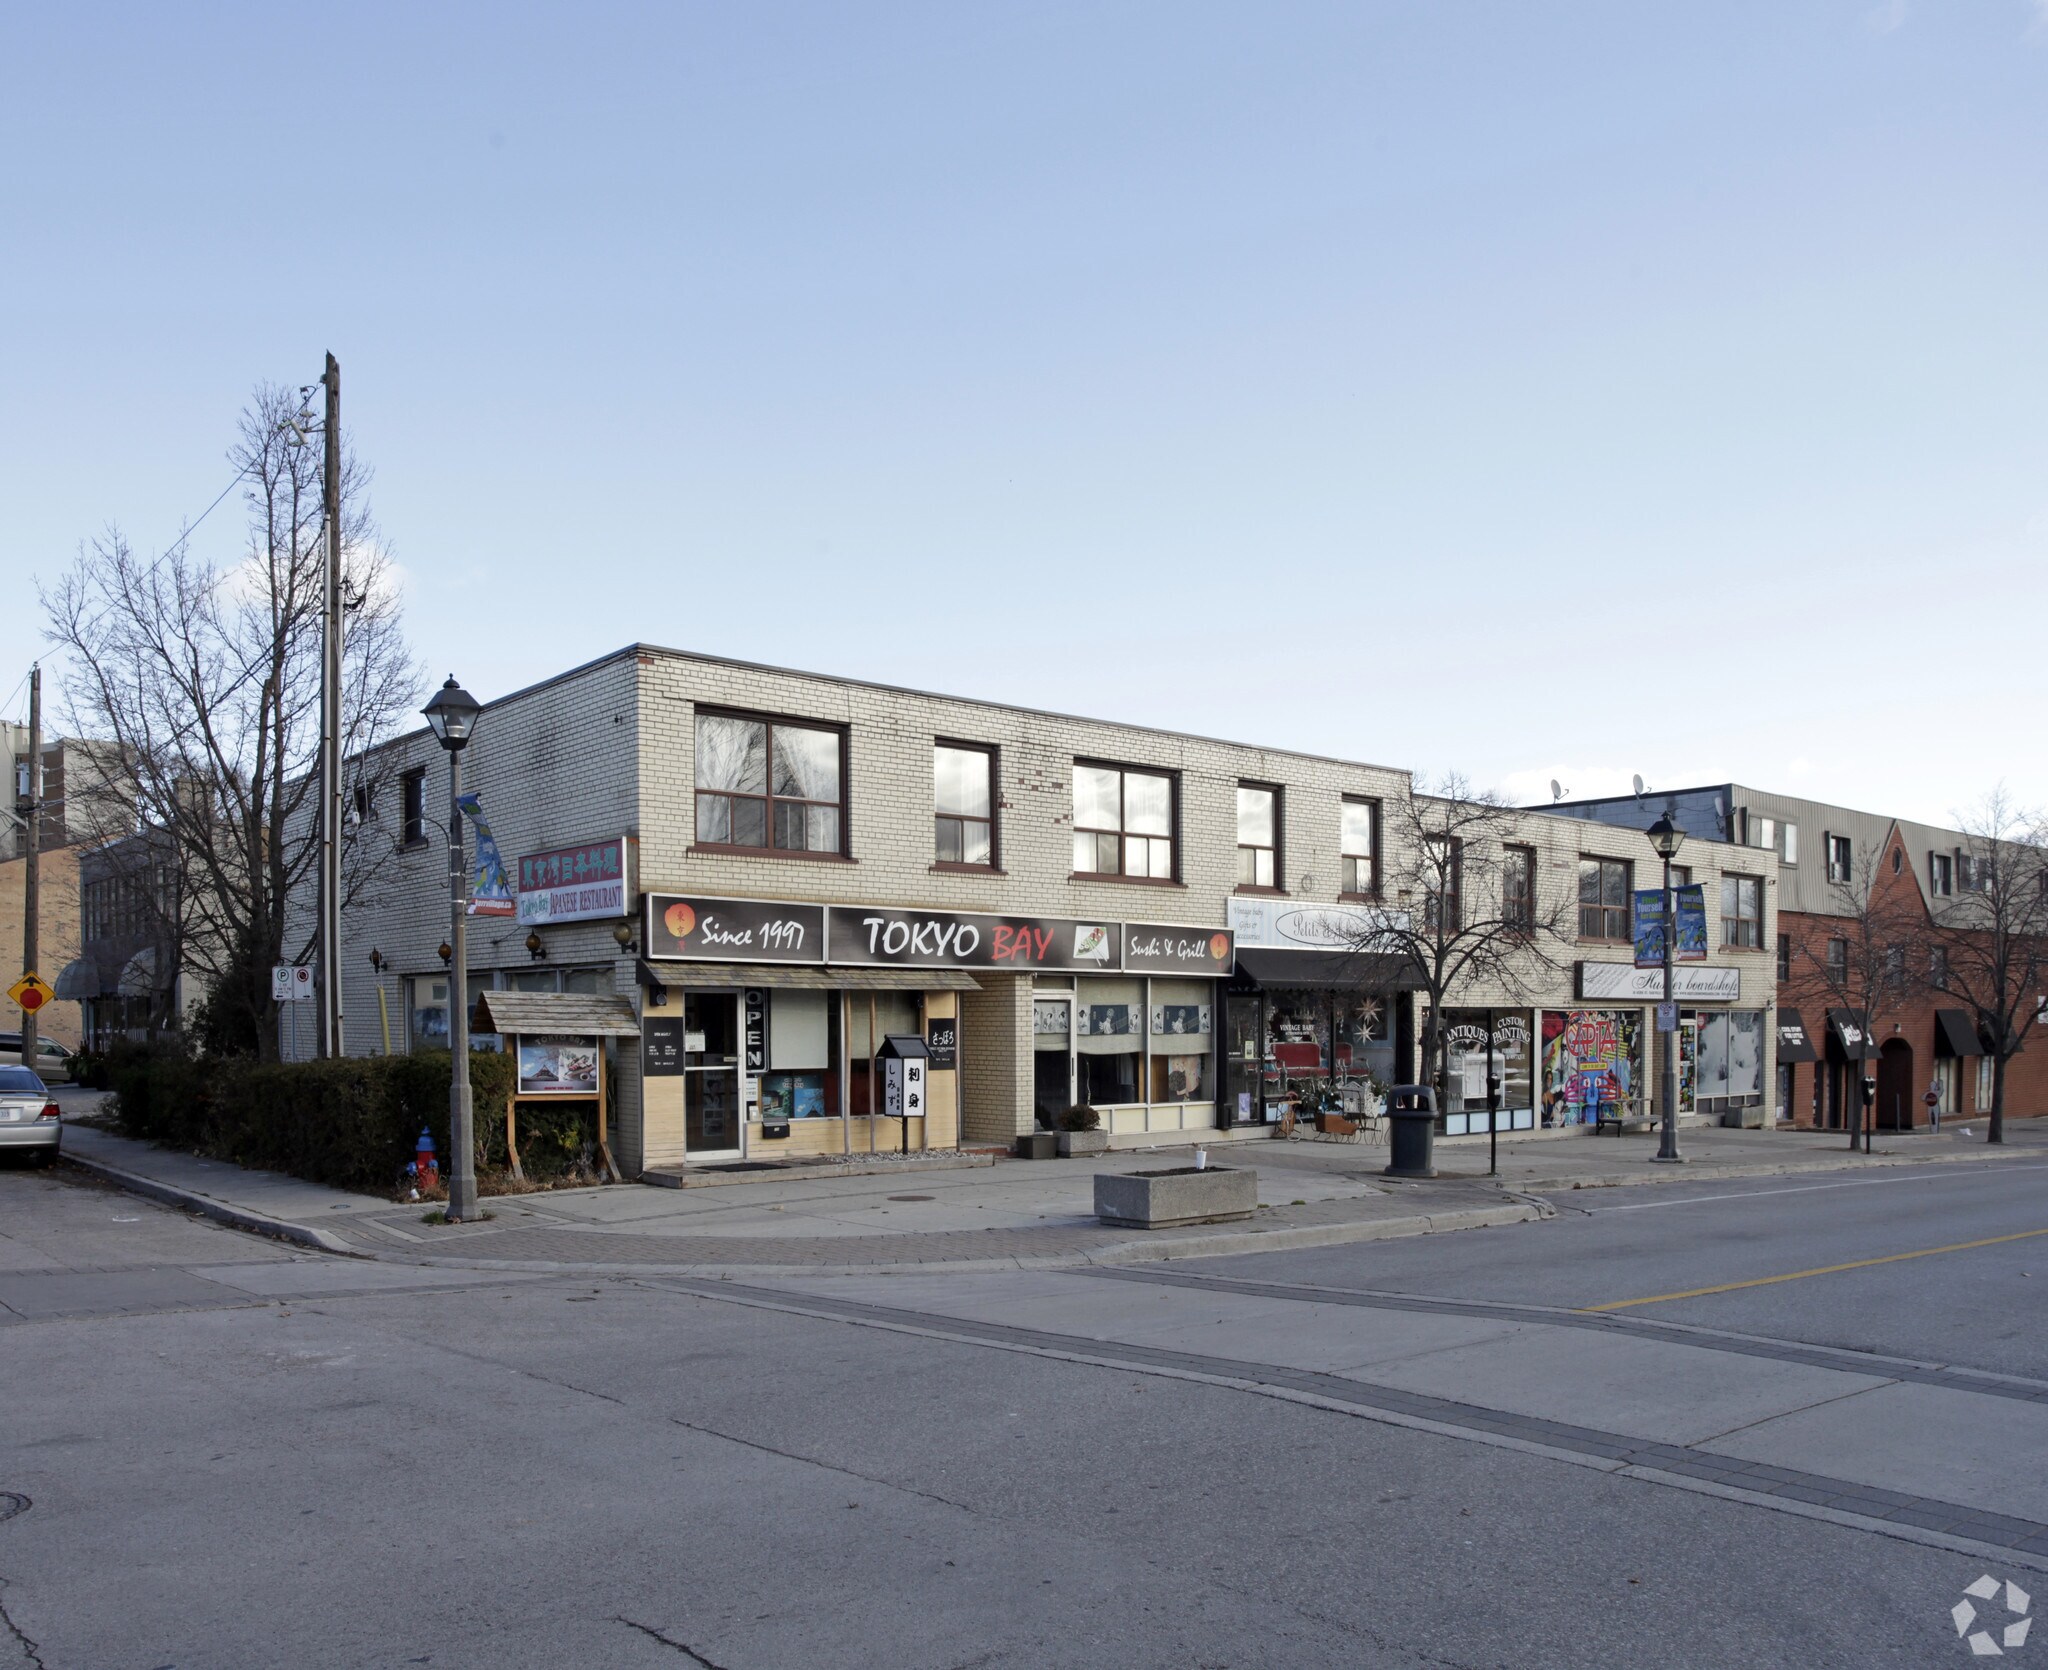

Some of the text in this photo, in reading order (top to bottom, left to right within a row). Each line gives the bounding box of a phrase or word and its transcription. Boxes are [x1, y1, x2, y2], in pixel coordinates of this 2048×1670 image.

[549, 891, 578, 917] JAPANESE
[579, 885, 622, 911] RESTAURANT
[1637, 902, 1664, 913] Yourself
[701, 916, 805, 950] Since 1997
[1293, 912, 1318, 937] Petits
[863, 917, 1054, 961] TOKYO BAY
[1130, 935, 1161, 957] Sushi
[1164, 938, 1173, 957] &
[1177, 939, 1206, 961] Grill
[1686, 968, 1738, 998] boardshop
[746, 991, 762, 1066] OPEN
[1447, 1025, 1489, 1043] ANTIQUES
[1497, 1016, 1525, 1028] CUSTOM
[535, 1034, 566, 1045] TOKYO
[1492, 1027, 1531, 1044] PAINTING
[887, 1064, 896, 1107] しみず
